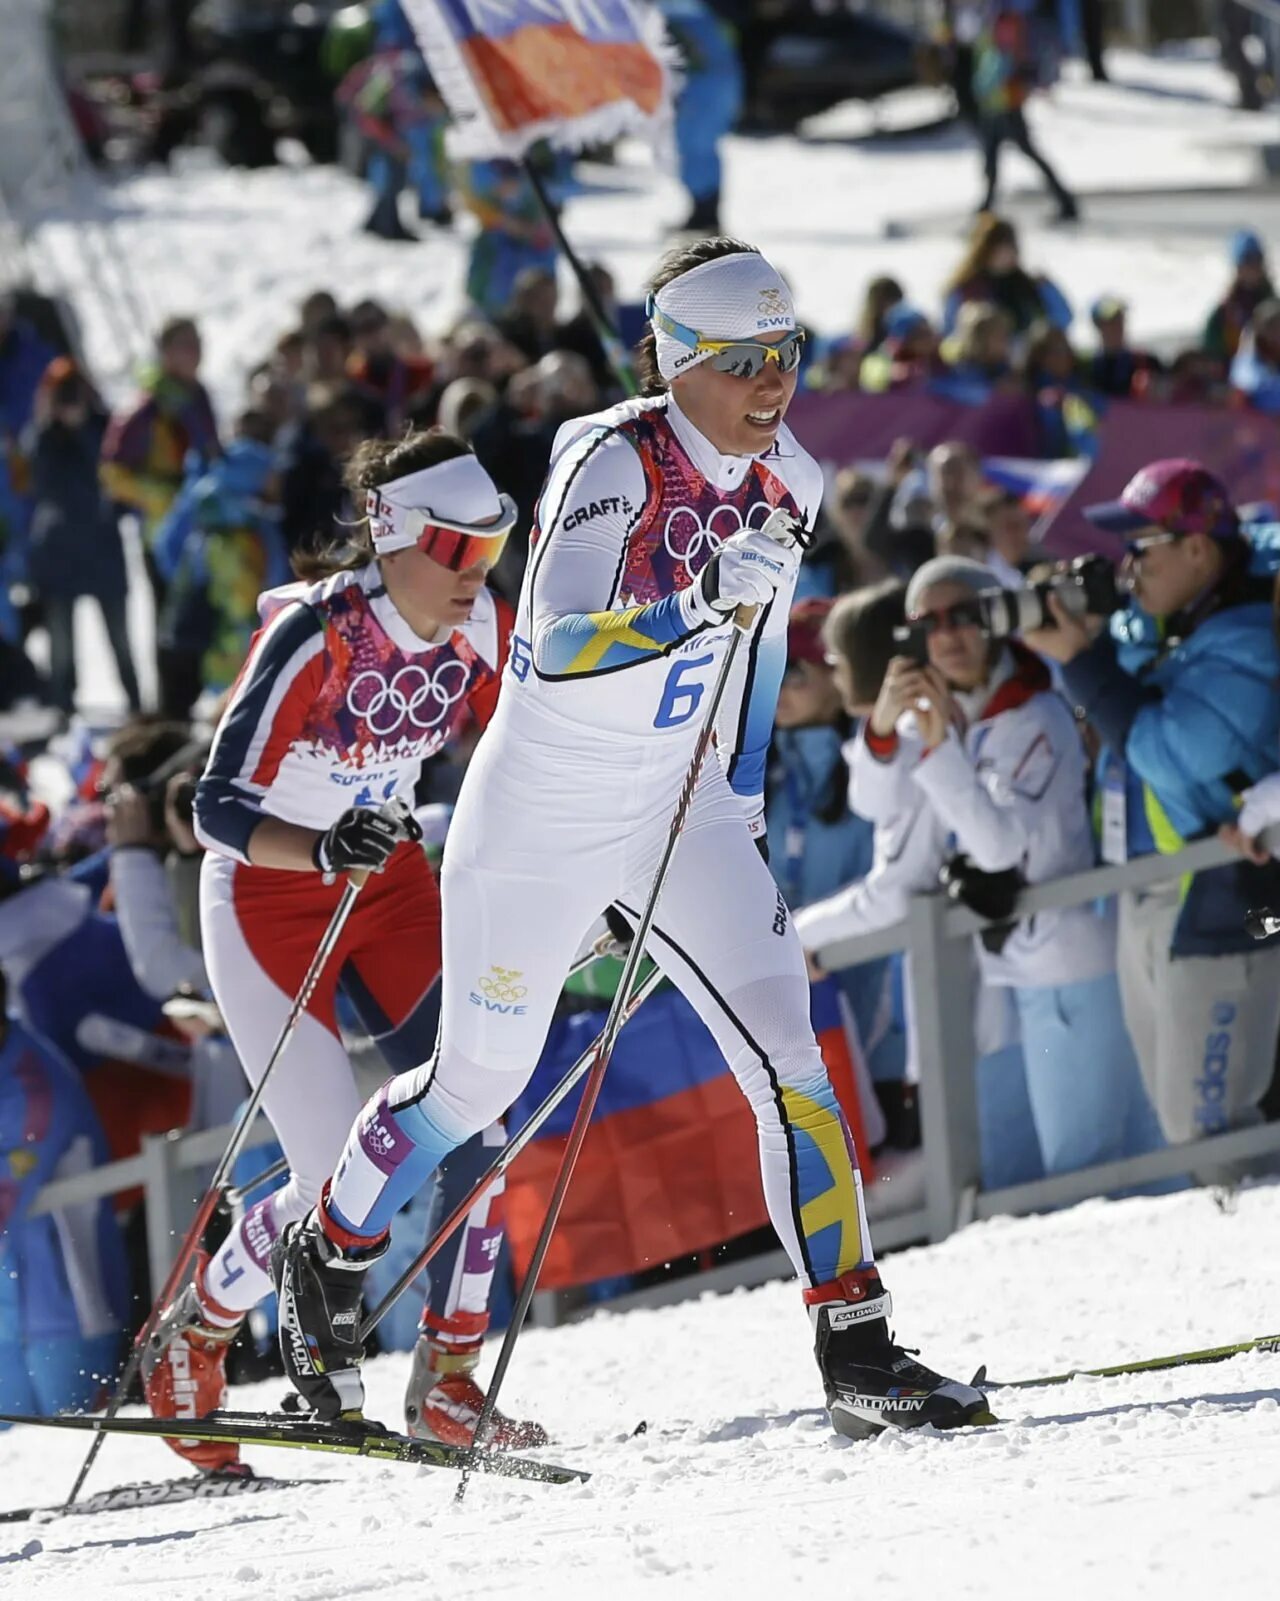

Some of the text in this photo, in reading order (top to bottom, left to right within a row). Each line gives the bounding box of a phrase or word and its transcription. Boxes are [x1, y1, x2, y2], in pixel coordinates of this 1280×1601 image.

[756, 316, 792, 329] SWE
[562, 496, 620, 532] CRAFT
[653, 652, 714, 729] 6
[468, 991, 529, 1016] SWE
[220, 1248, 245, 1290] 4
[836, 1302, 884, 1322] SALOMON
[842, 1393, 925, 1411] SALOMON
